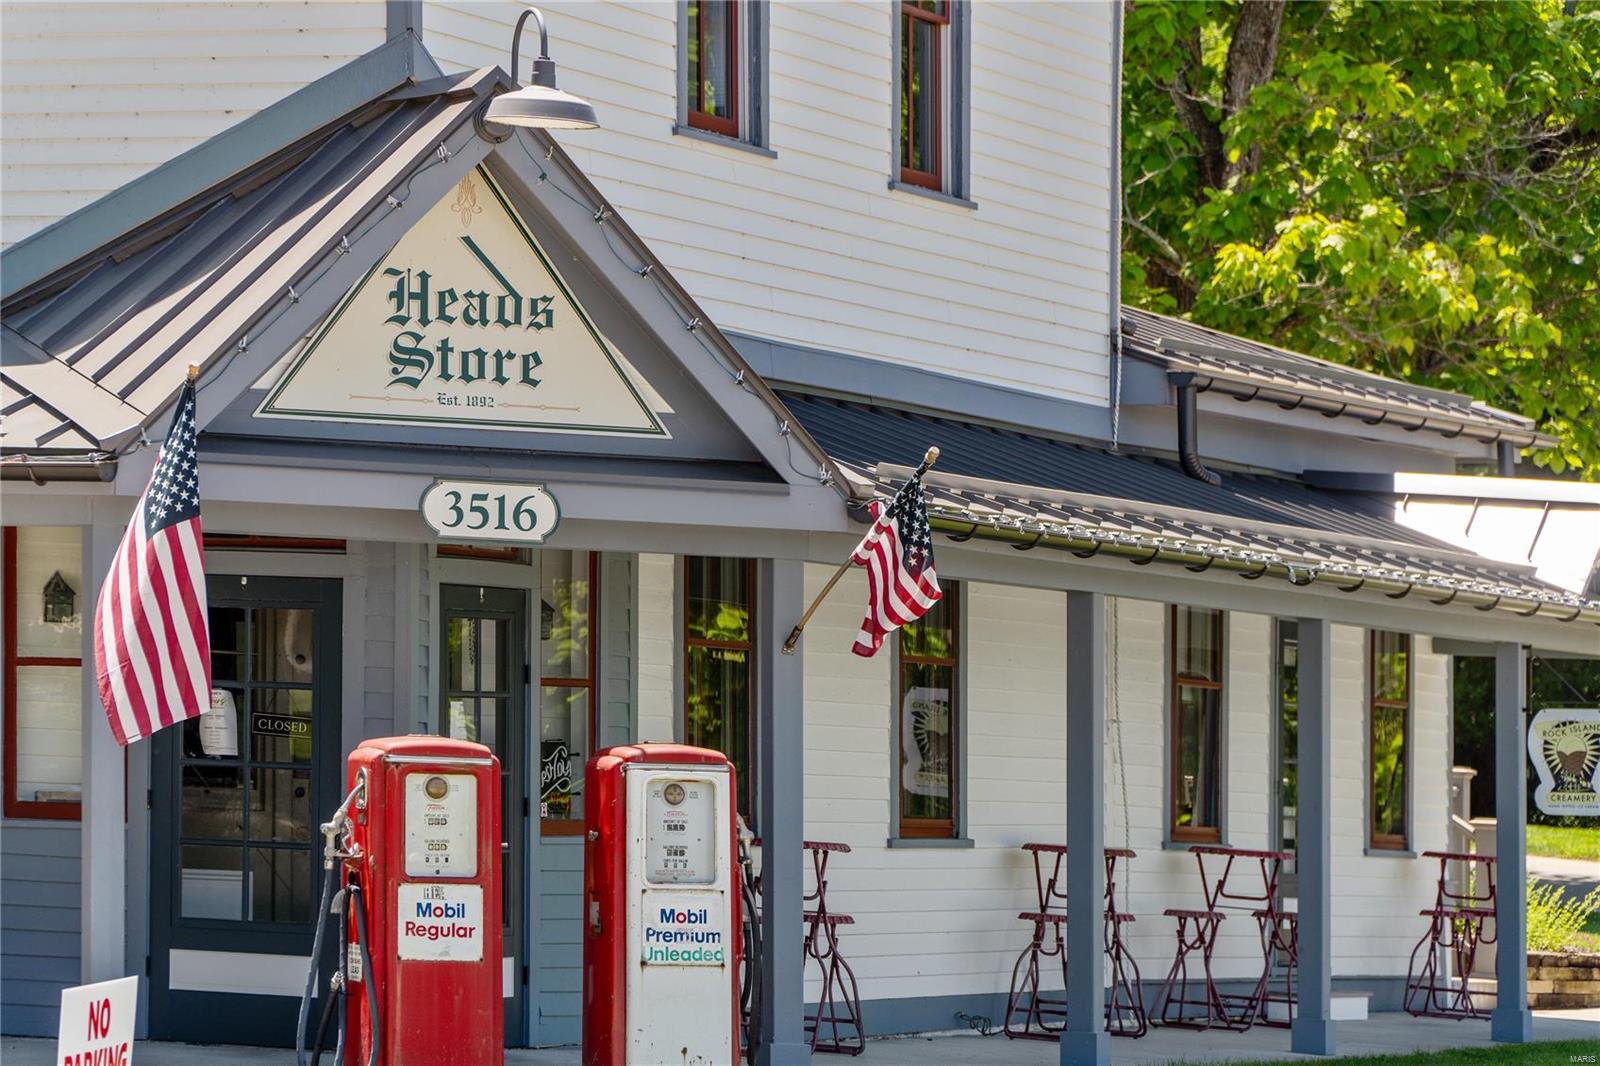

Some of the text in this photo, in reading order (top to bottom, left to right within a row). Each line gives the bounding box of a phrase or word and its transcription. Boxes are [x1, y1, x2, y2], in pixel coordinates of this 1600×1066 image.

[382, 235, 556, 332] Heads
[384, 330, 544, 389] Store
[437, 392, 495, 408] Est. 1892
[441, 490, 538, 532] 3516
[258, 718, 308, 733] CLOSED
[1542, 729, 1568, 738] ROCK
[1550, 793, 1597, 802] CREAMERY
[416, 902, 465, 919] Mobil
[660, 908, 708, 925] Mobil
[405, 921, 476, 941] Regular
[645, 927, 722, 944] Premium
[87, 997, 111, 1041] NO
